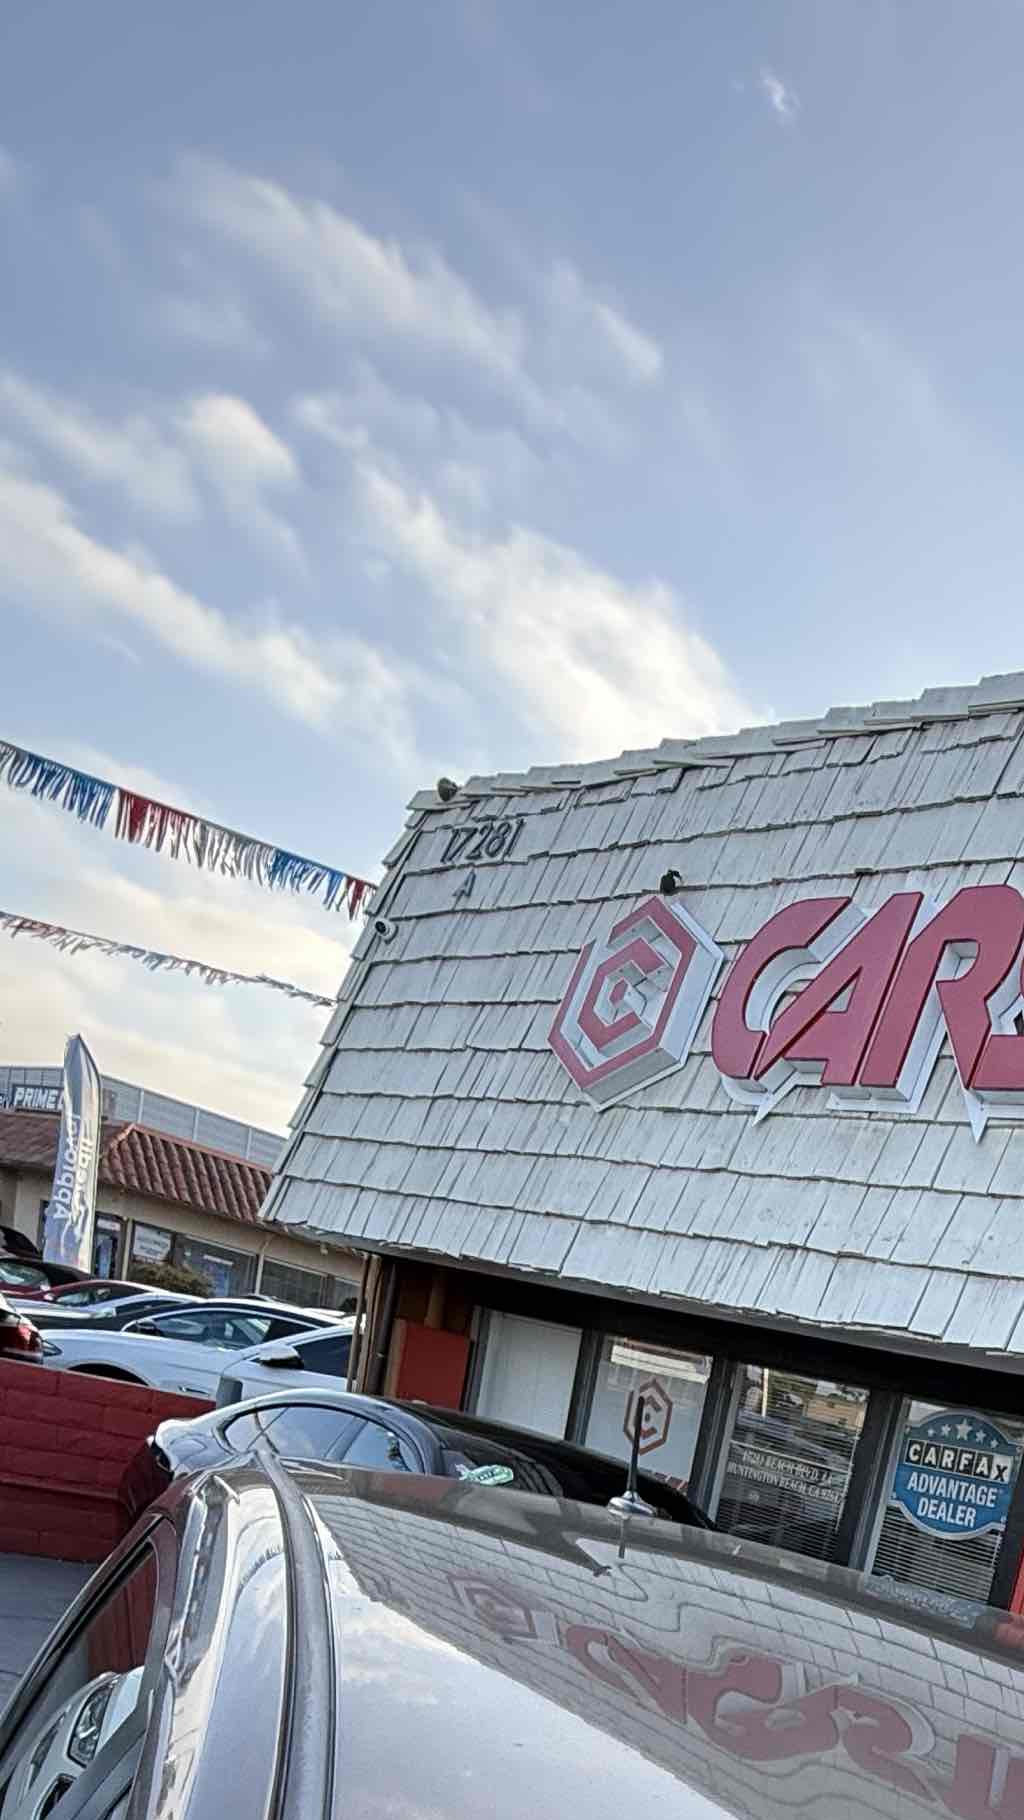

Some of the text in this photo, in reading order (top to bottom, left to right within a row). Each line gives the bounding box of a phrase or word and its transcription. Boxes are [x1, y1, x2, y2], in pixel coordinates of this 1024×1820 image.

[440, 818, 526, 862] 17281
[14, 1087, 59, 1109] PRIME
[908, 1443, 1009, 1482] CARFAX
[907, 1471, 998, 1508] ADVANTAGE
[917, 1497, 977, 1528] DEALER
